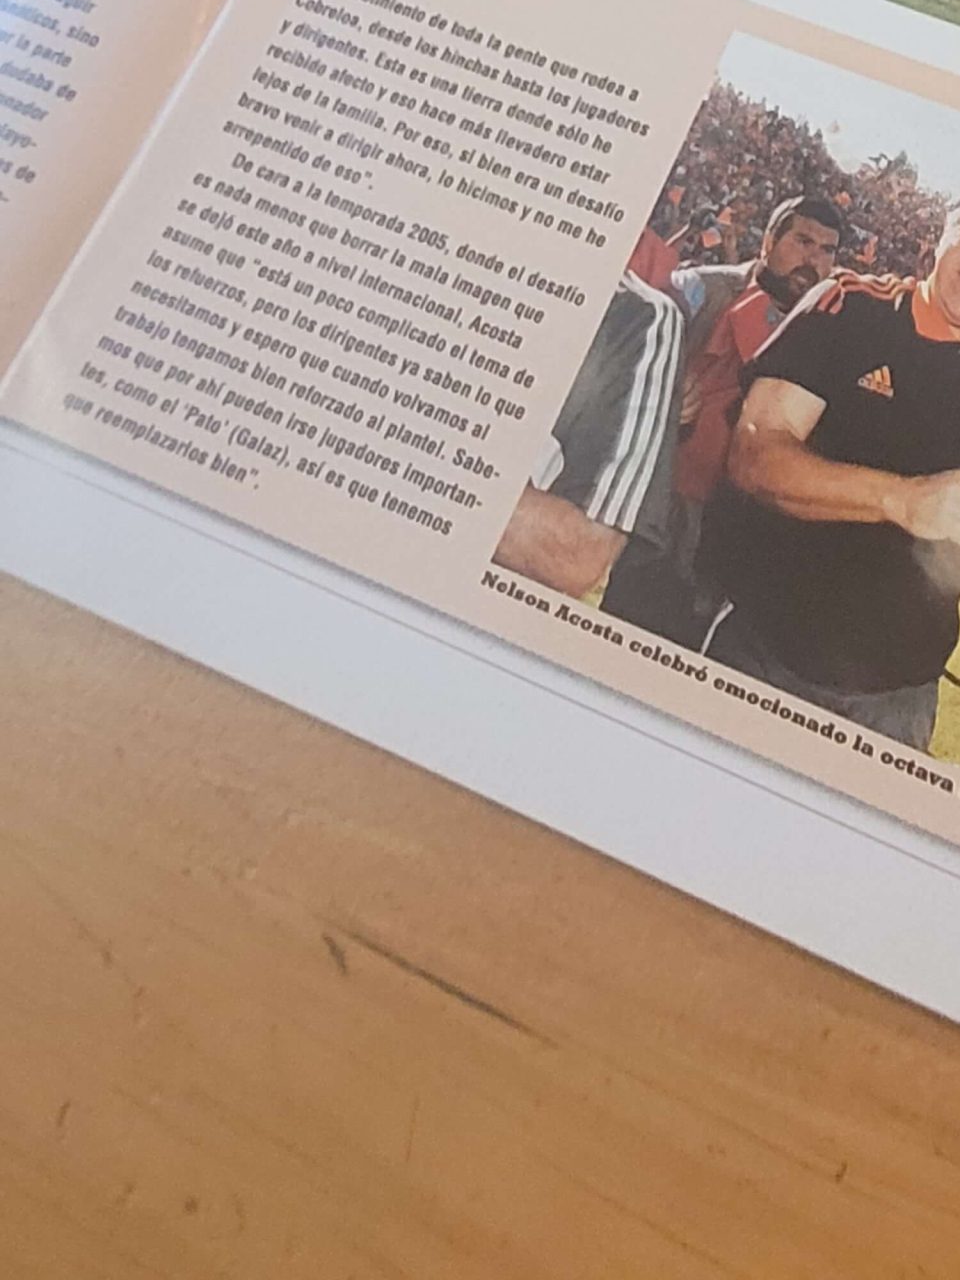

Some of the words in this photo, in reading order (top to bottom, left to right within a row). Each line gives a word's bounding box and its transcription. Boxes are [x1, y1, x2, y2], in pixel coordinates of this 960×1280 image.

[266, 44, 327, 77] recibido
[329, 67, 375, 95] afecto
[419, 99, 456, 126] hace
[459, 117, 493, 140] más
[494, 128, 567, 168] llevadero
[569, 160, 611, 185] estar
[292, 22, 368, 63] dirigentes.
[374, 51, 406, 76] Esta
[461, 85, 503, 113] tierra
[506, 103, 553, 132] donde
[556, 123, 589, 146] sólo
[368, 20, 413, 48] desde
[440, 46, 500, 81] hinchas
[501, 68, 544, 97] hasta
[570, 95, 650, 137] jugadores
[450, 21, 483, 44] toda
[503, 43, 547, 68] gente
[580, 71, 625, 97] rodea
[223, 120, 310, 164] arrepentido
[237, 91, 281, 121] bravo
[283, 112, 323, 136] venir
[337, 132, 384, 160] dirigir
[385, 151, 431, 183] ahora,
[456, 176, 519, 214] hicimos
[252, 66, 291, 93] lejos
[332, 97, 387, 132] familia.
[392, 120, 422, 143] Por
[422, 135, 453, 160] eso,
[476, 152, 512, 179] bien
[566, 188, 624, 223] desafío
[162, 226, 214, 256] asume
[216, 248, 246, 270] que
[313, 289, 354, 314] poco
[356, 306, 447, 353] complicado
[468, 347, 510, 379] tema
[199, 206, 236, 231] dejó
[236, 223, 270, 245] este
[271, 238, 302, 258] año
[316, 256, 358, 281] nivel
[358, 268, 463, 329] internacional,
[467, 315, 523, 350] Acosta
[213, 181, 252, 205] nada
[254, 197, 307, 228] menos
[308, 219, 338, 240] que
[340, 228, 390, 260] borrar
[408, 259, 449, 285] mala
[451, 273, 512, 311] imagen
[514, 302, 545, 324] que
[256, 165, 290, 188] cara
[324, 189, 405, 234] temporada
[406, 223, 450, 256] 2005,
[455, 243, 504, 274] donde
[526, 271, 585, 307] desafío
[114, 305, 170, 341] trabajo
[171, 329, 249, 374] tengamos
[251, 361, 287, 391] bien
[288, 381, 364, 424] reforzado
[383, 422, 446, 460] plantel.
[452, 447, 500, 479] Sabe-
[130, 280, 228, 330] necesitamos
[243, 327, 297, 359] espero
[299, 350, 330, 373] que
[331, 365, 390, 399] cuando
[392, 389, 469, 433] volvamos
[173, 264, 247, 308] refuerzos,
[251, 297, 290, 322] pero
[291, 309, 318, 333] los
[319, 323, 398, 367] dirigentes
[422, 367, 472, 399] saben
[494, 397, 526, 420] que
[64, 394, 94, 415] que
[94, 407, 209, 465] reemplazarlos
[80, 361, 107, 388] tes,
[114, 378, 158, 407] como
[227, 425, 290, 468] (Galaz),
[296, 457, 326, 479] así
[347, 479, 379, 503] que
[381, 489, 453, 536] tenemos
[97, 336, 132, 359] mos
[134, 351, 164, 373] que
[163, 365, 195, 386] por
[195, 377, 227, 399] ahí
[222, 390, 284, 425] pueden
[285, 411, 318, 440] irse
[317, 426, 401, 476] jugadores
[402, 462, 482, 509] importan-
[481, 570, 550, 613] Nelson
[554, 603, 623, 646] Acosta
[629, 640, 709, 682] celebró
[713, 677, 847, 744] emocionado
[852, 734, 874, 758] la
[880, 751, 954, 794] octava
